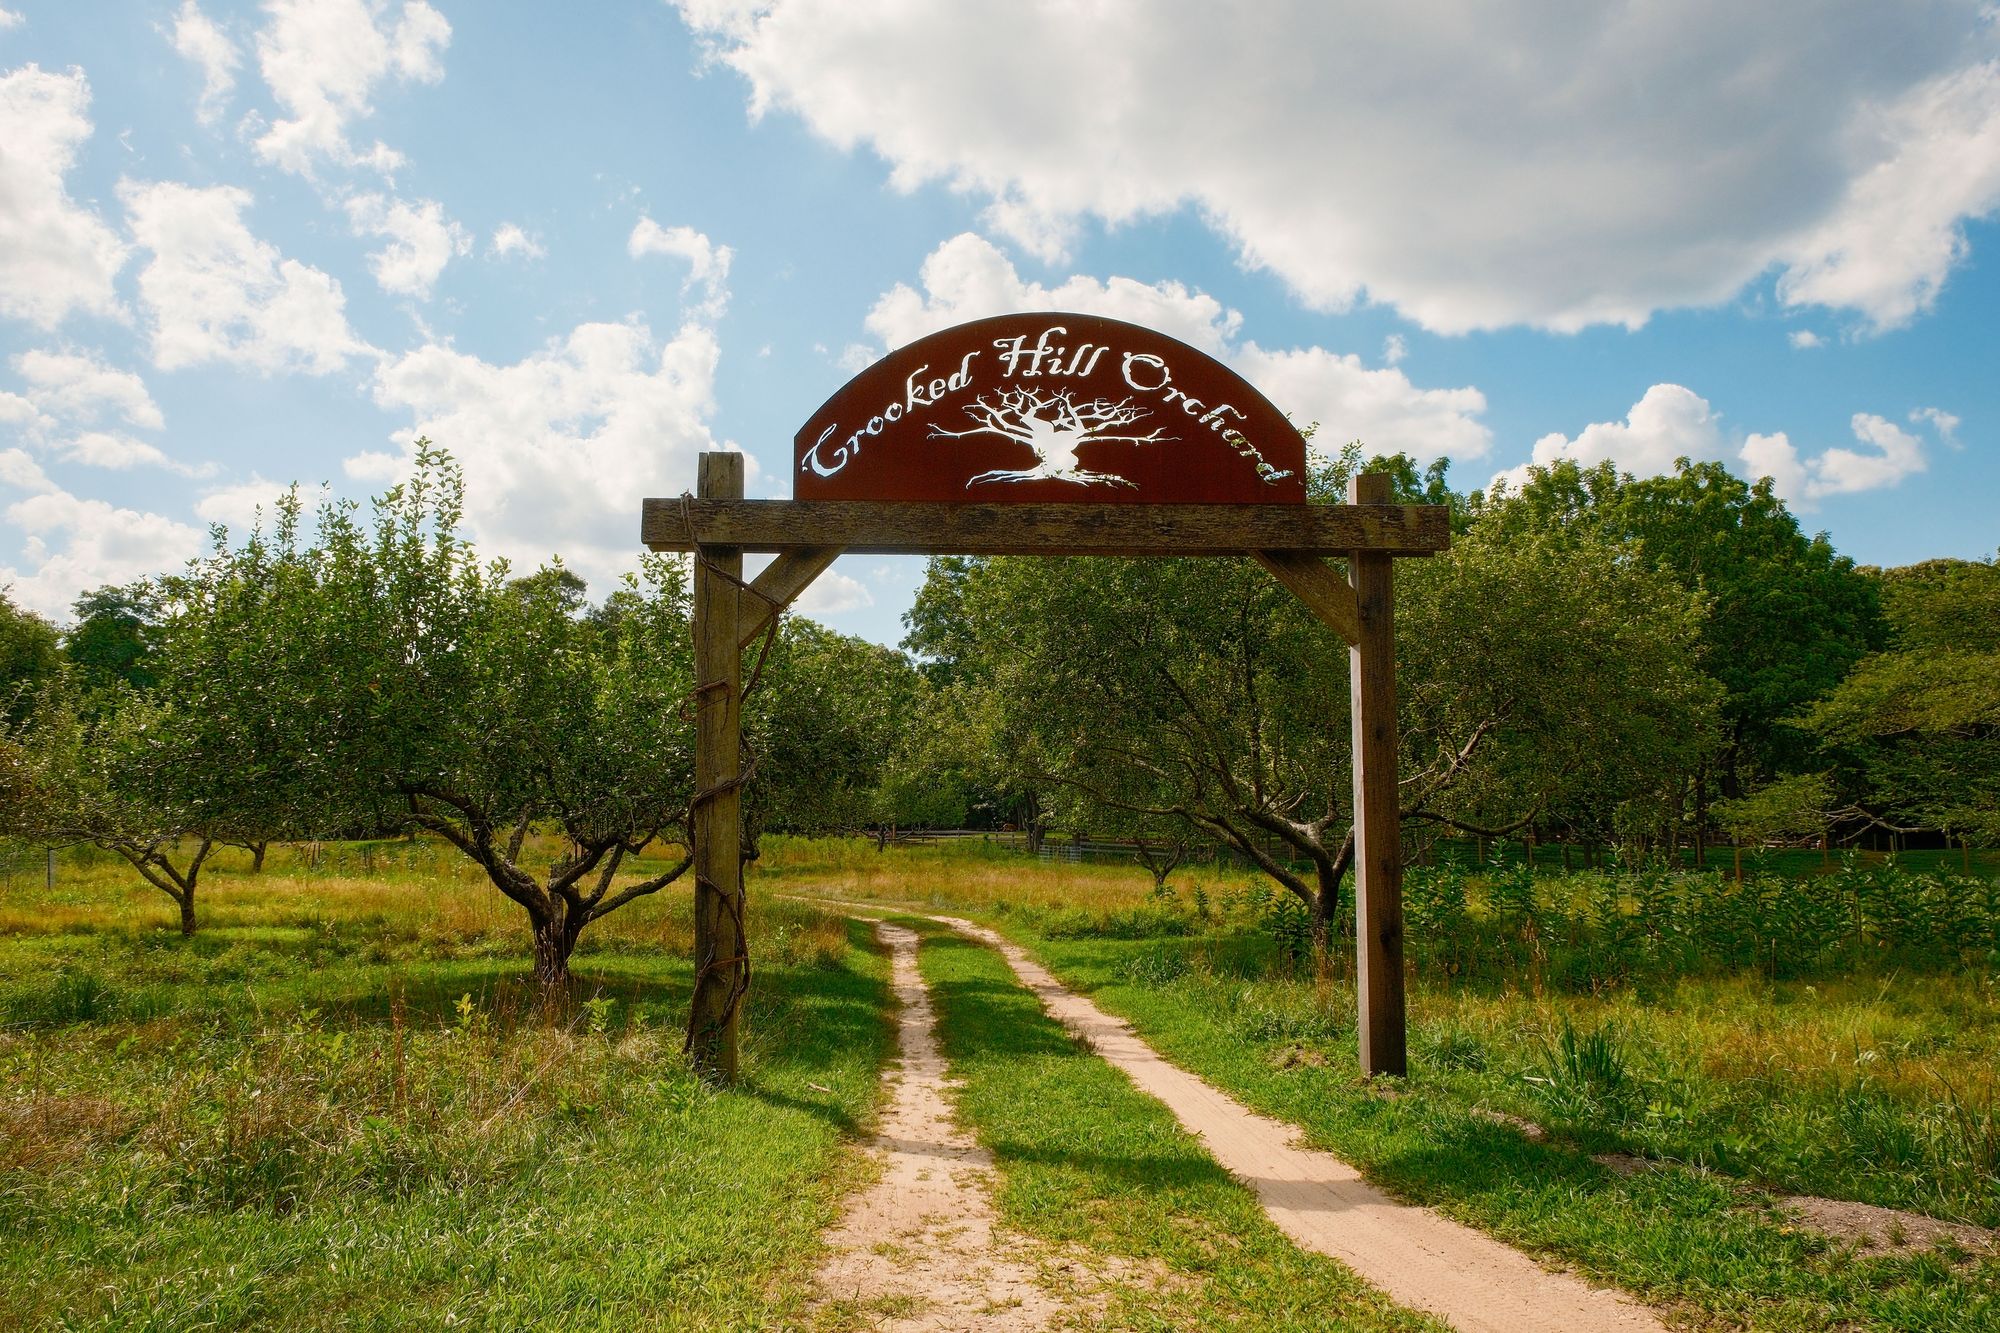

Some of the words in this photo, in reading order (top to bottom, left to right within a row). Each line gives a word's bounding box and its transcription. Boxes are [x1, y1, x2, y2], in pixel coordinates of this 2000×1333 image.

[802, 351, 981, 478] Crooked
[993, 326, 1110, 378] Hill
[1121, 351, 1297, 487] Orchard
